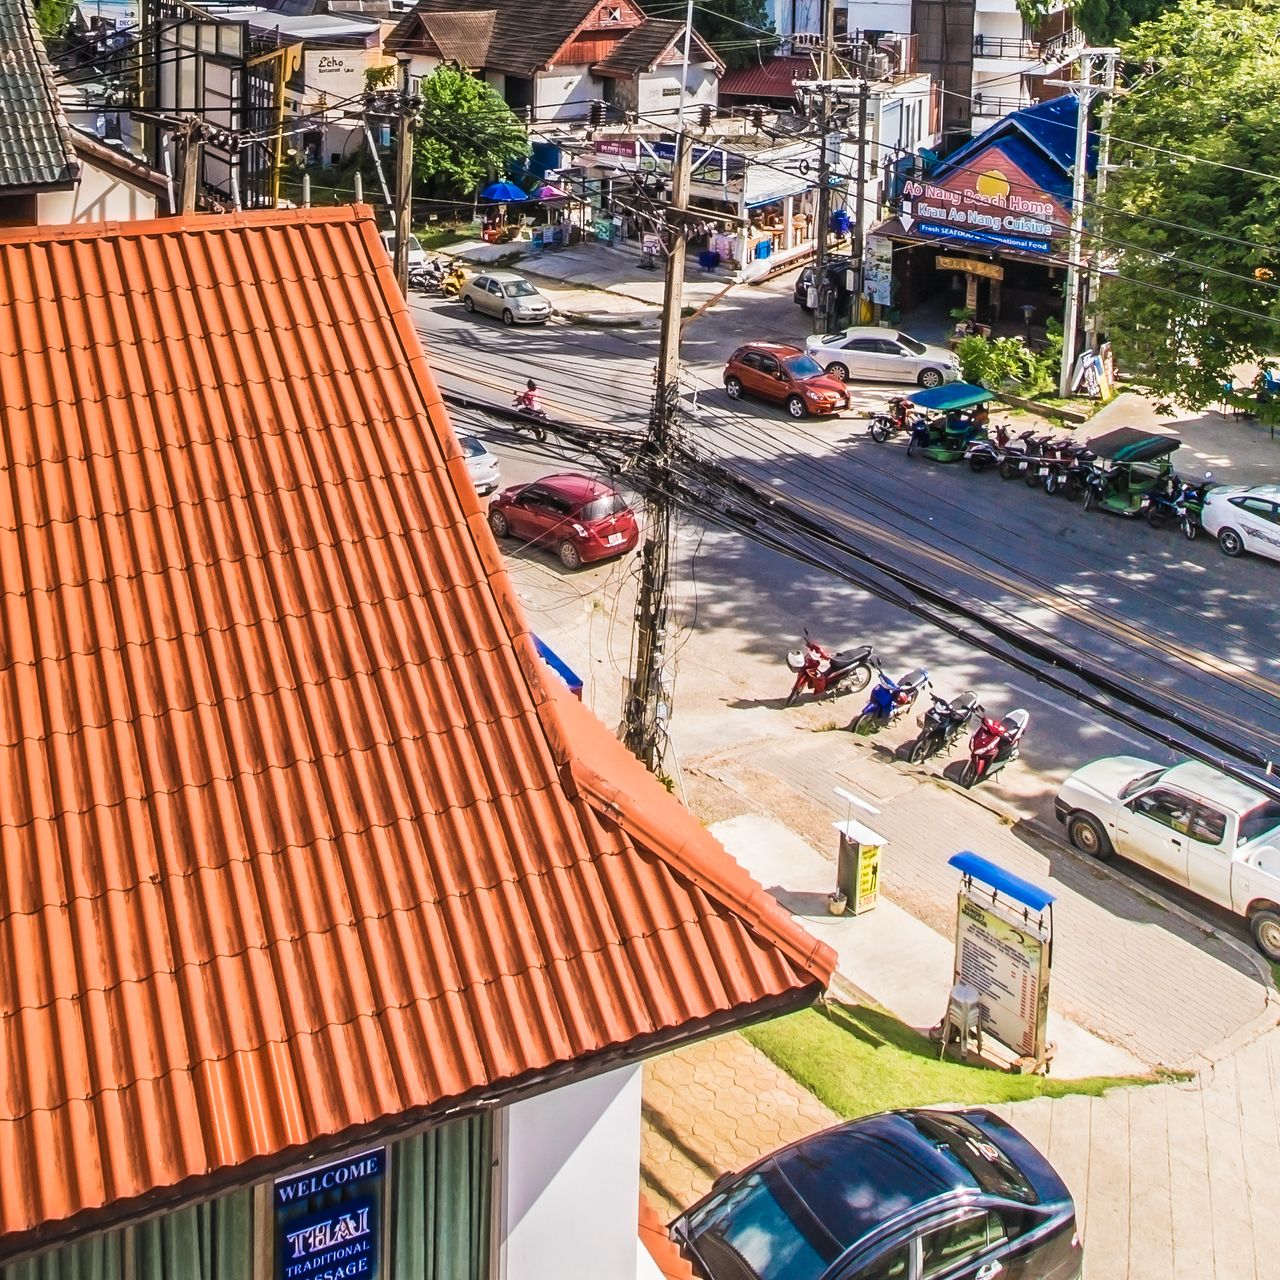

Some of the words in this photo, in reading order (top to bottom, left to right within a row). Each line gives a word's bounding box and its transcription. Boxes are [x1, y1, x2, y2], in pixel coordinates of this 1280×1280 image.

[318, 56, 344, 68] Echo
[903, 181, 923, 196] Ao
[925, 185, 962, 205] Nang
[963, 189, 1007, 209] Beach
[1010, 196, 1053, 215] Home
[918, 203, 947, 220] Krau
[948, 207, 967, 223] Ao
[968, 210, 1002, 231] Nang
[921, 224, 940, 233] Fresh
[1028, 241, 1047, 250] Food
[279, 1157, 378, 1202] WELCOME
[286, 1206, 370, 1258] THAI
[286, 1241, 370, 1277] TRADITIONAL
